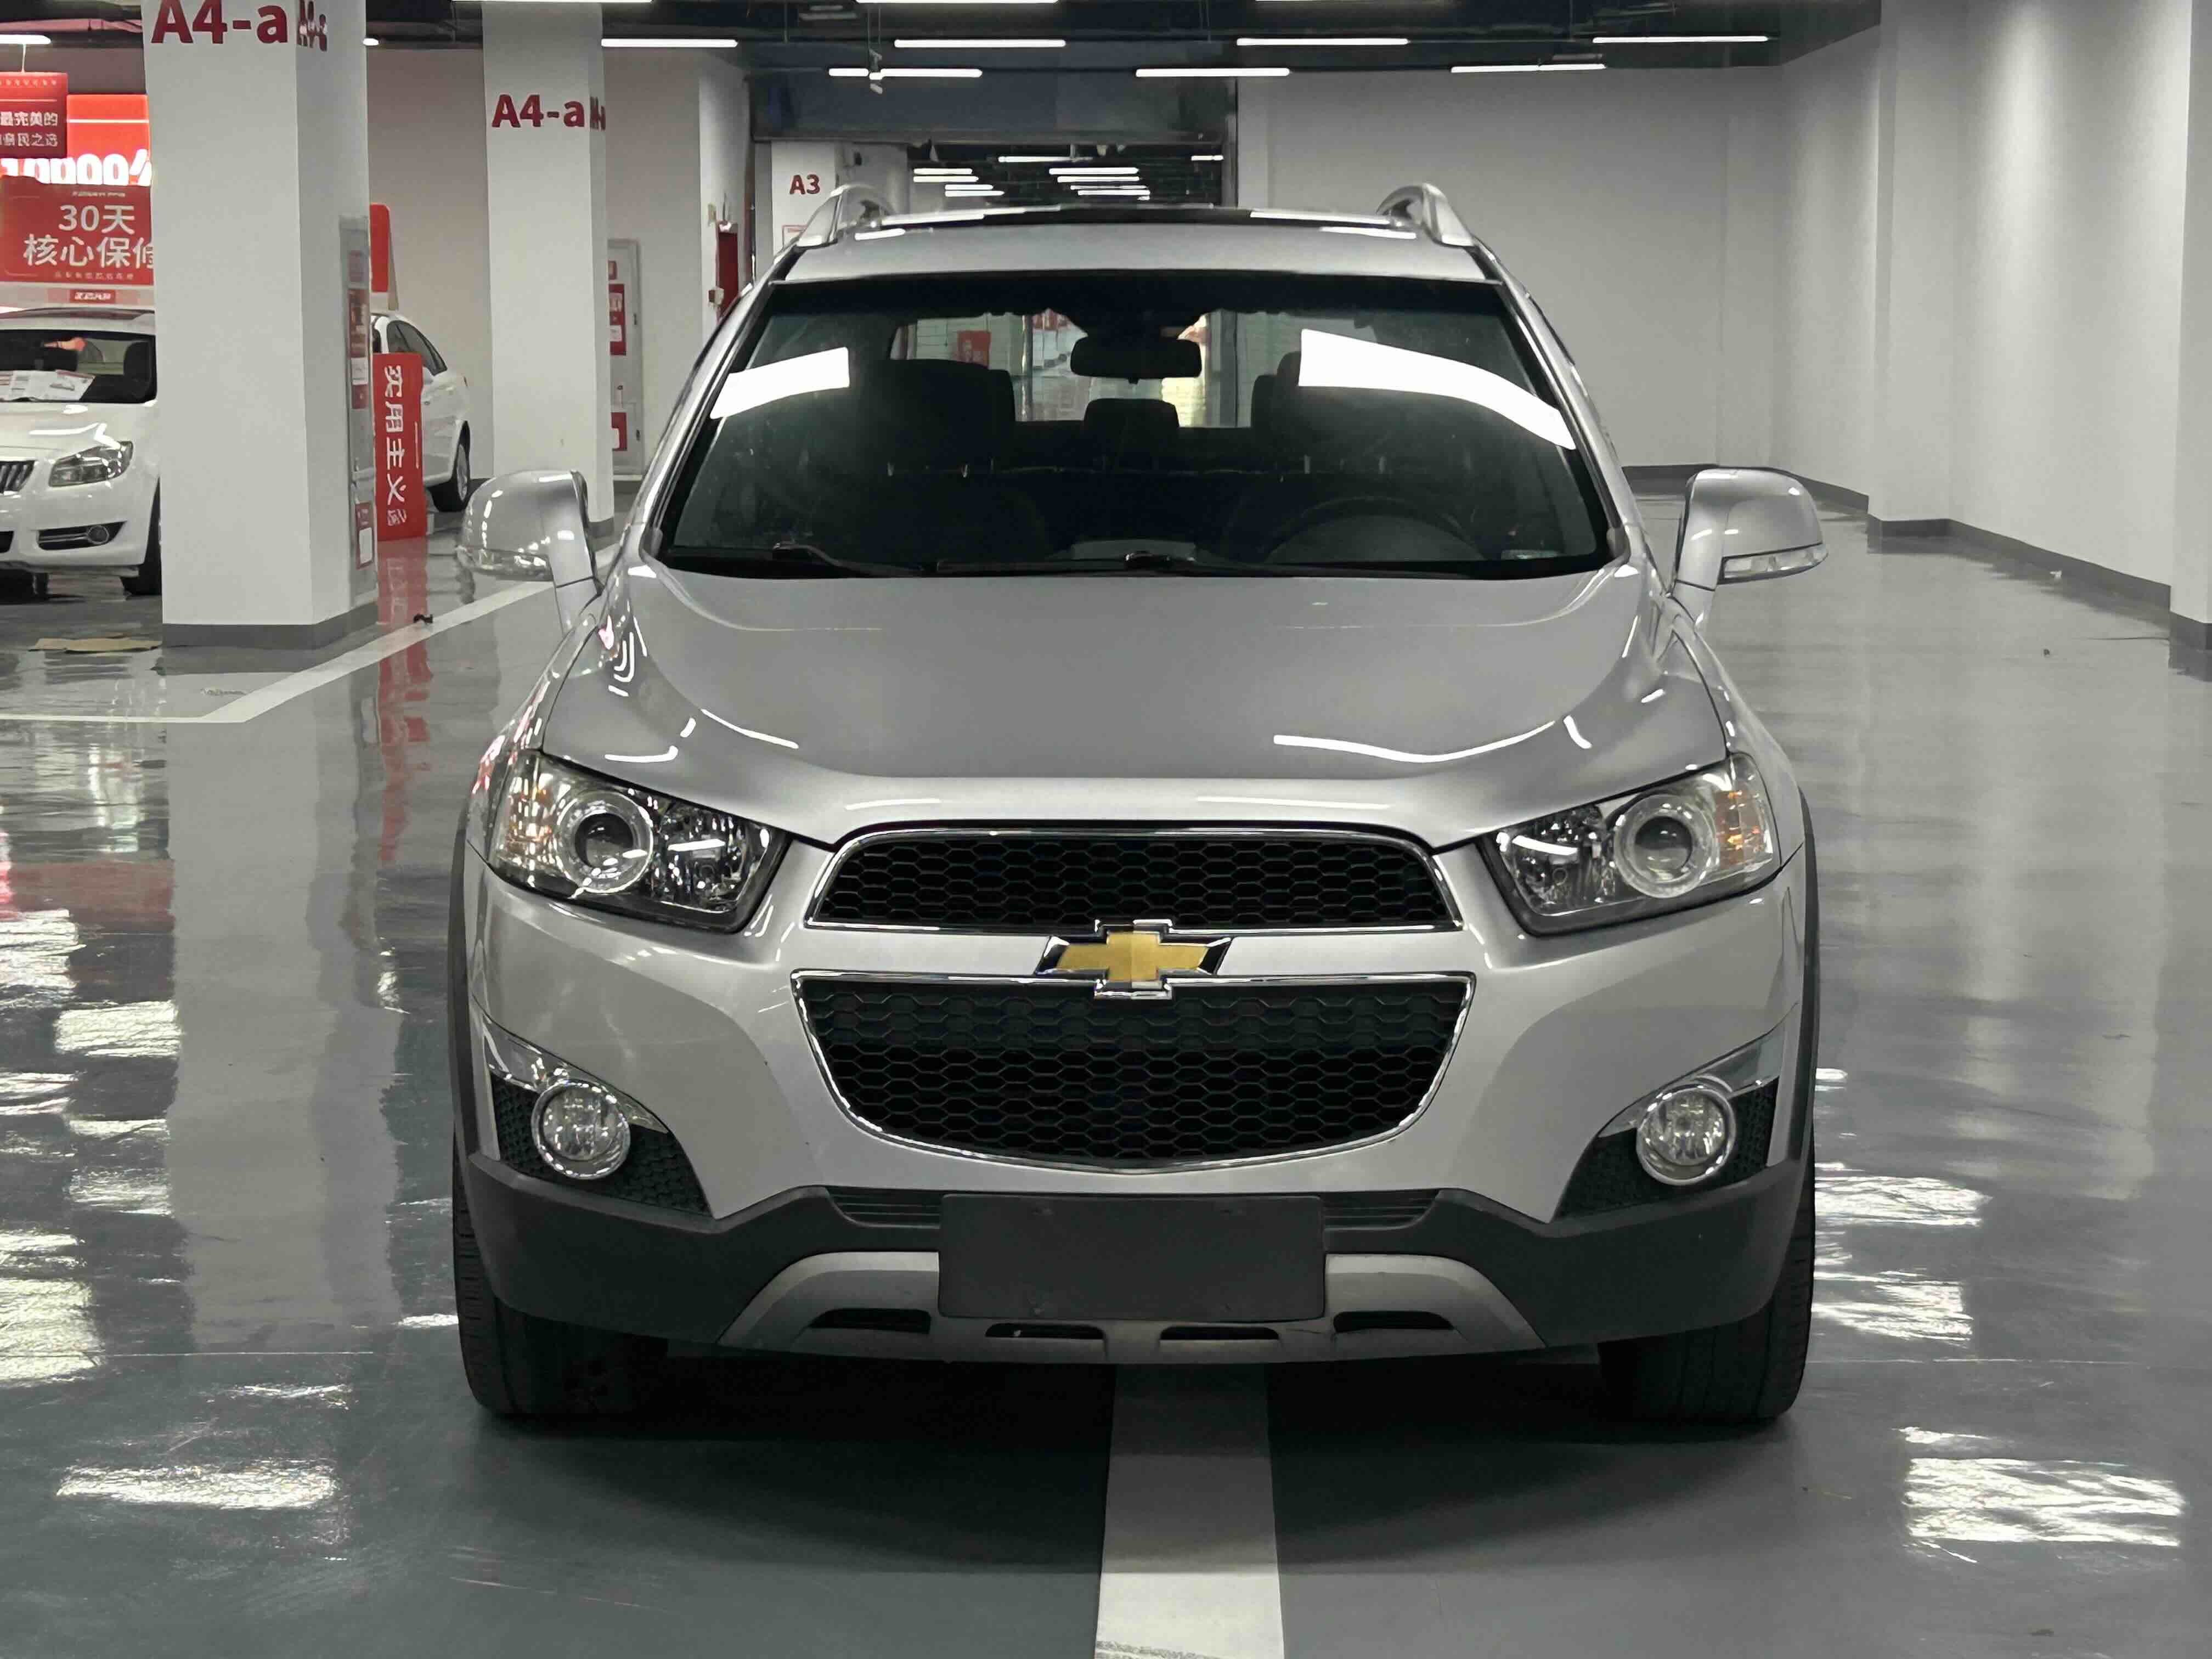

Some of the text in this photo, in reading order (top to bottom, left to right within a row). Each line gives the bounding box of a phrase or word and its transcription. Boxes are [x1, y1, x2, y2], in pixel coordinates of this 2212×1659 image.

[151, 0, 288, 44] A4-a
[492, 94, 585, 128] A4-a
[789, 174, 821, 195] A3
[58, 205, 135, 234] 30天
